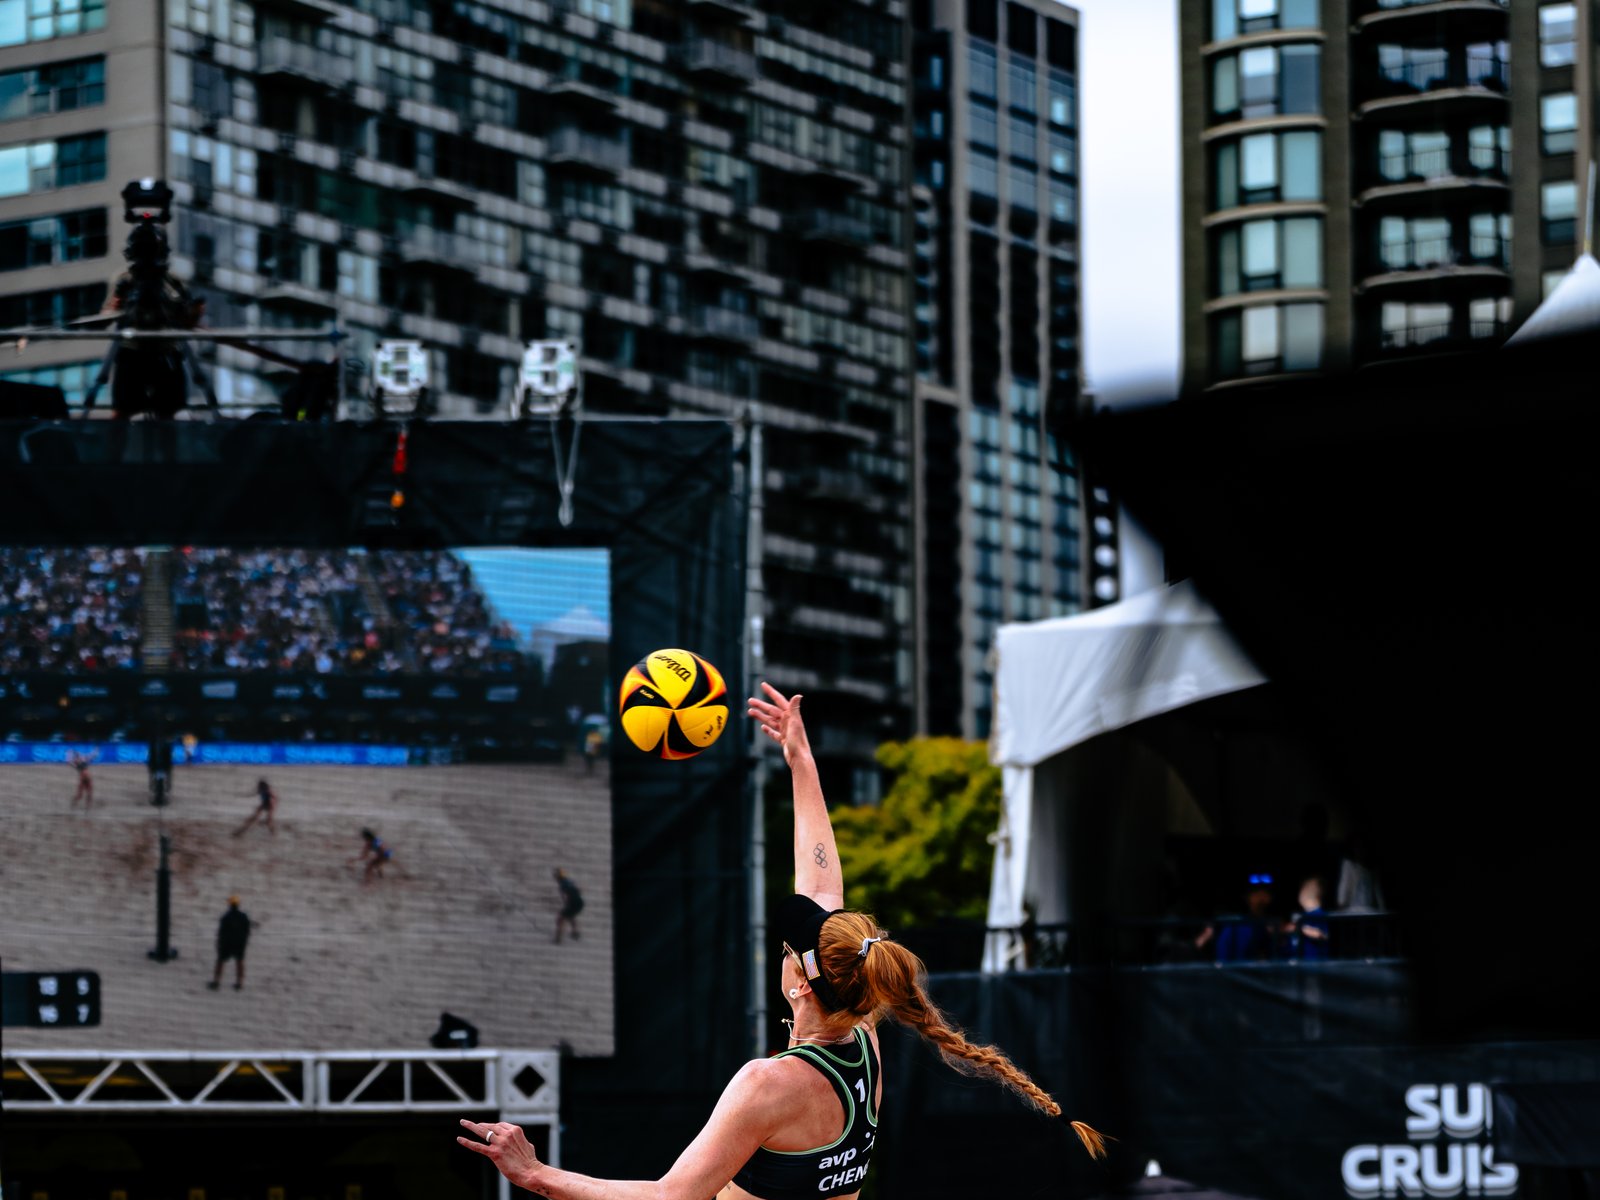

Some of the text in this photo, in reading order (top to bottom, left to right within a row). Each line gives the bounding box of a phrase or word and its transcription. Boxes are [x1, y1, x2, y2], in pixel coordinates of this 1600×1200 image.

[854, 1077, 866, 1103] 1
[818, 1147, 857, 1170] avp
[818, 1158, 871, 1192] CHEN
